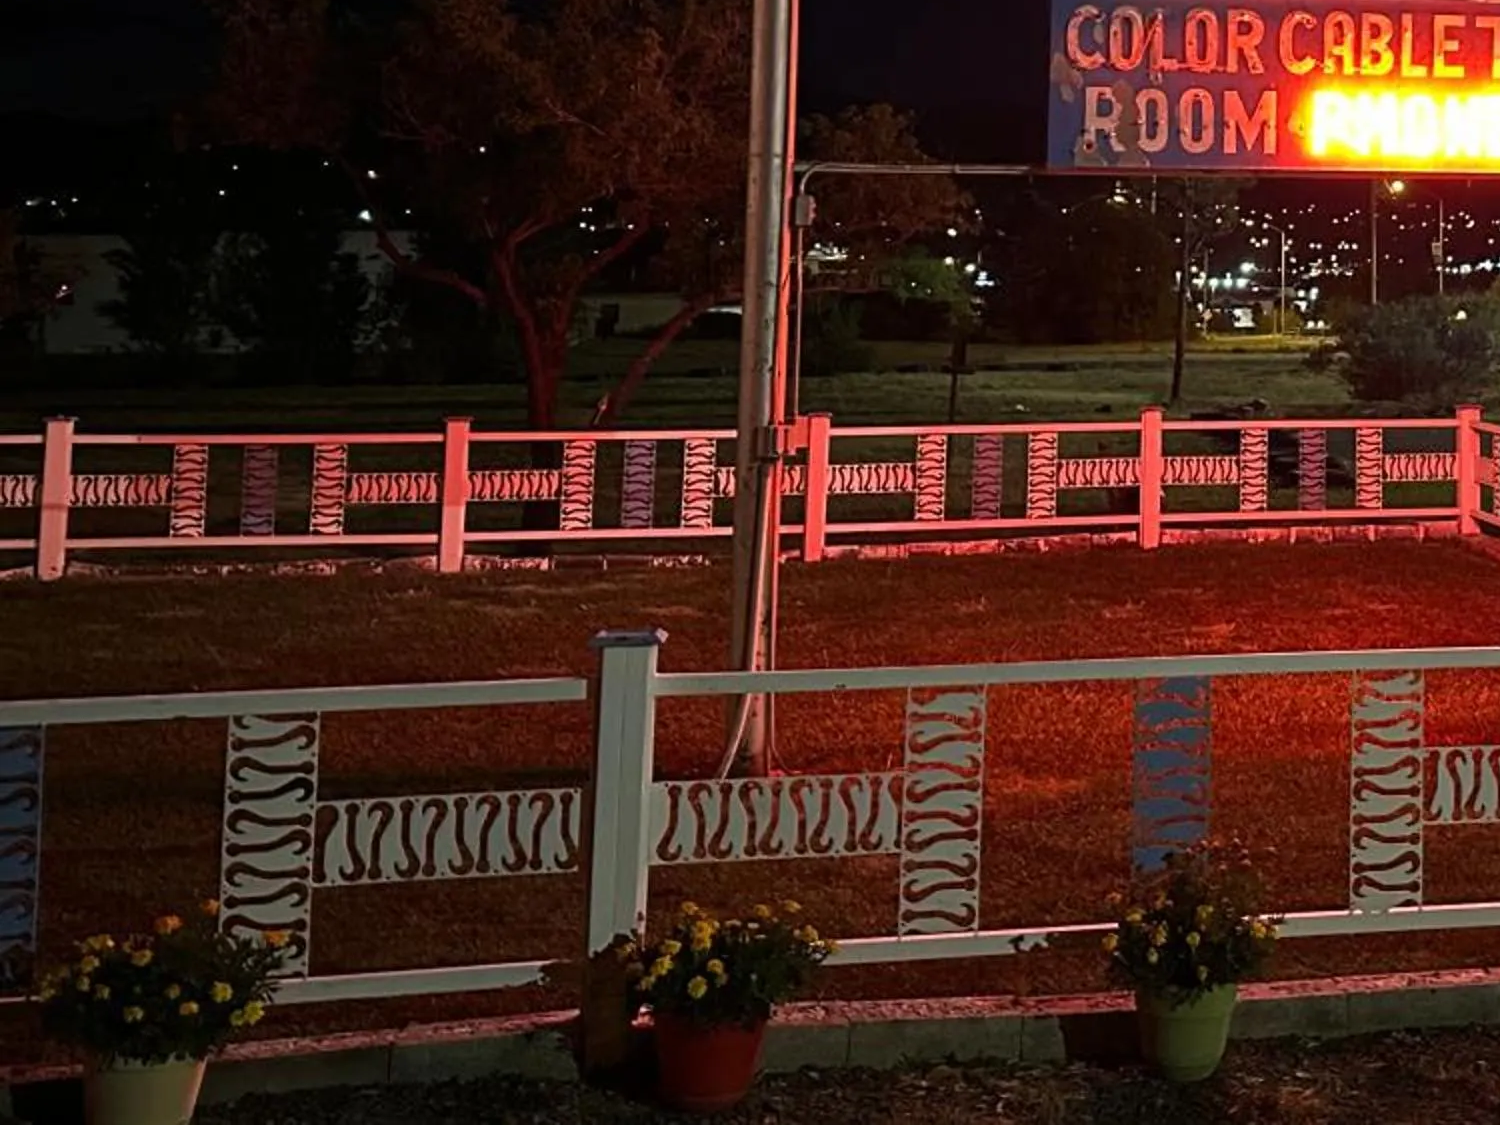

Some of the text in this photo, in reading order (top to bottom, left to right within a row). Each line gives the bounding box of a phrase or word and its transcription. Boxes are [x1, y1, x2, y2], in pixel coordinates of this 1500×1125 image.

[1065, 4, 1266, 75] COLOR
[1279, 10, 1467, 79] CABLE
[1079, 85, 1277, 156] ROOM
